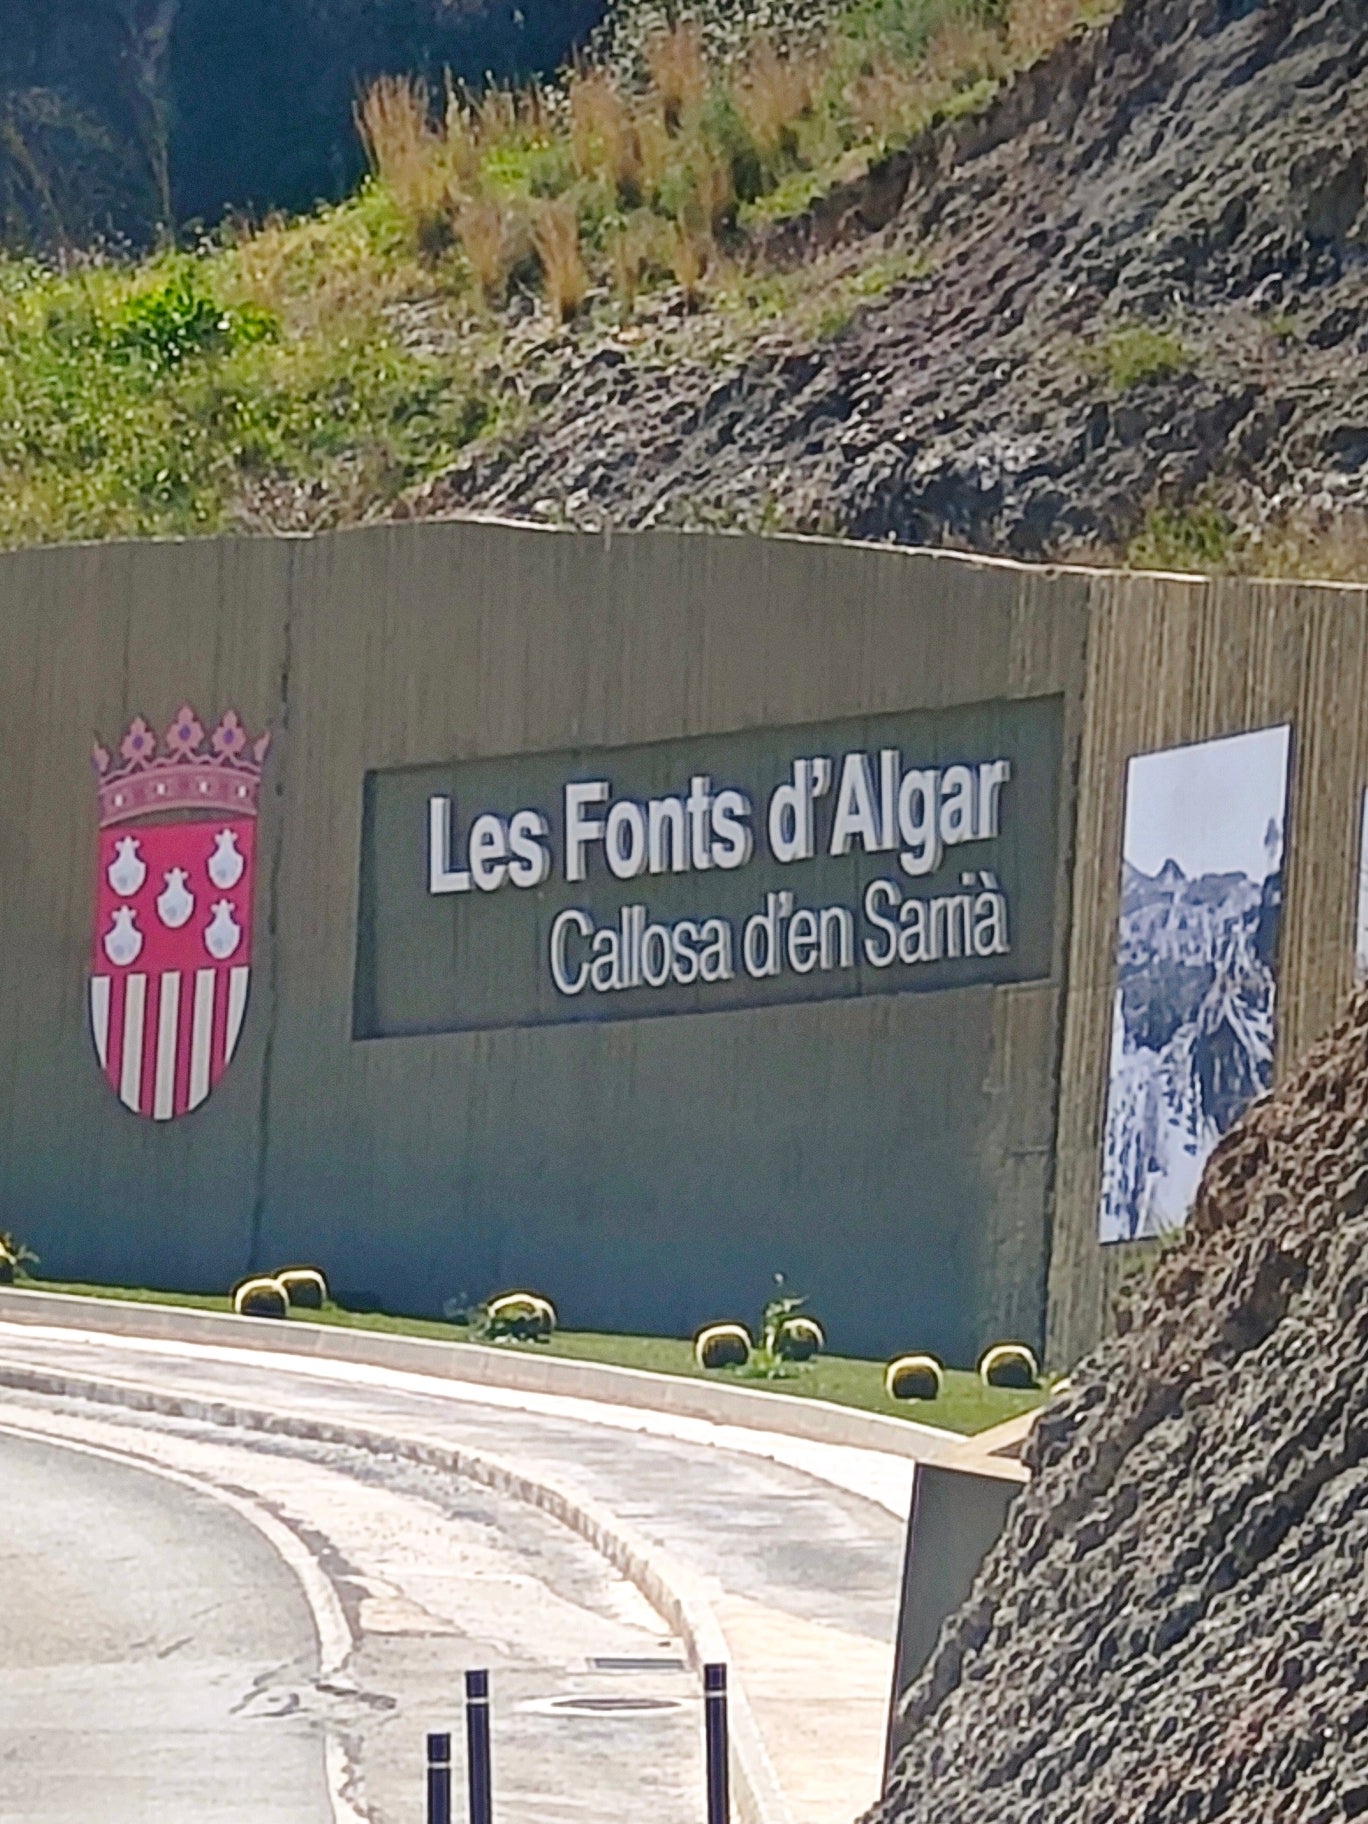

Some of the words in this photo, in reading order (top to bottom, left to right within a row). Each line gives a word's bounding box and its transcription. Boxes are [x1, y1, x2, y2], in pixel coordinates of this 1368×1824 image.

[429, 796, 551, 893] Les
[564, 775, 753, 882] Fonts
[768, 748, 1011, 876] d'Algar
[549, 904, 734, 996] Callosa
[742, 891, 857, 979] d'en
[862, 869, 1011, 968] Sarrià
